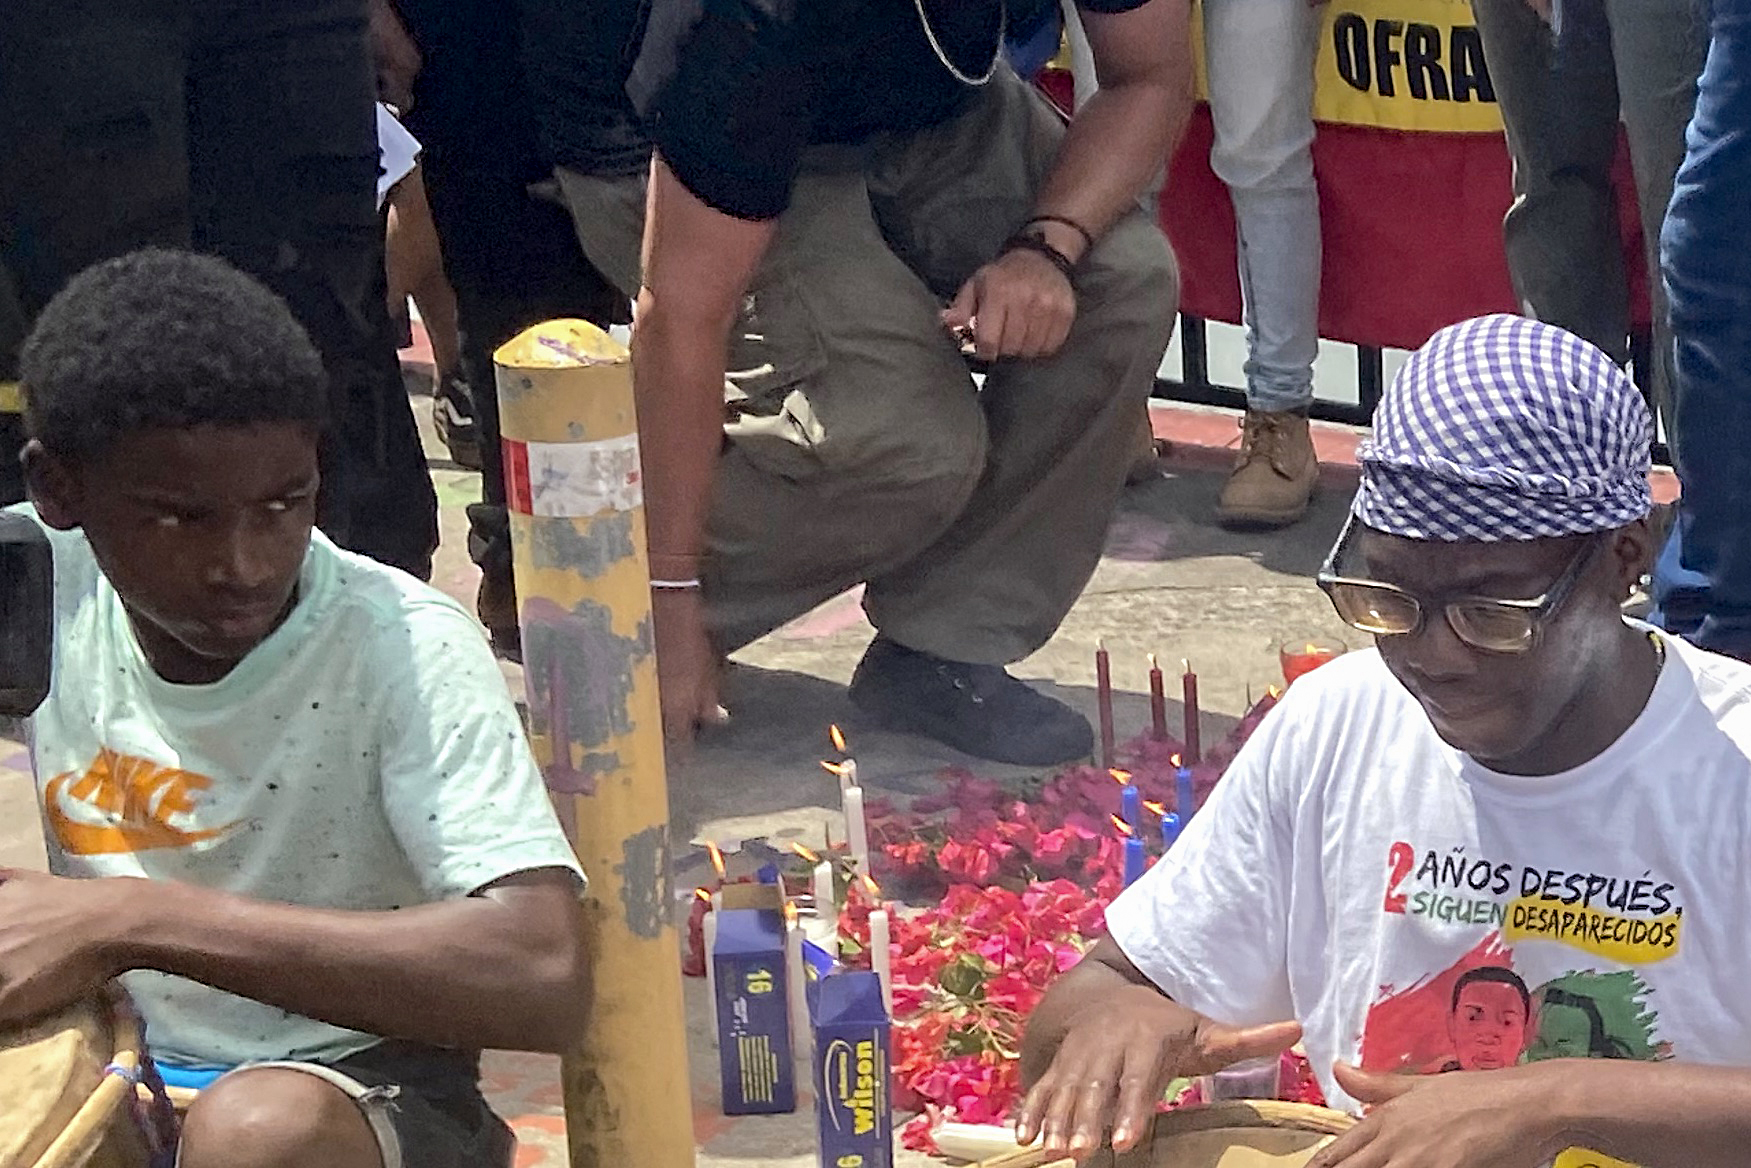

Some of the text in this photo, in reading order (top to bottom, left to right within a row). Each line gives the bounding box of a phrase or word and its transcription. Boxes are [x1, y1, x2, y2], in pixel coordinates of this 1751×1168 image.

[1334, 13, 1497, 103] OFRA
[1384, 842, 1684, 917] 2 AÑOS DESPUÉS,
[1411, 891, 1678, 949] SIGUEN DESAPARECIDOS
[746, 969, 773, 994] 16
[842, 1041, 875, 1135] wilson
